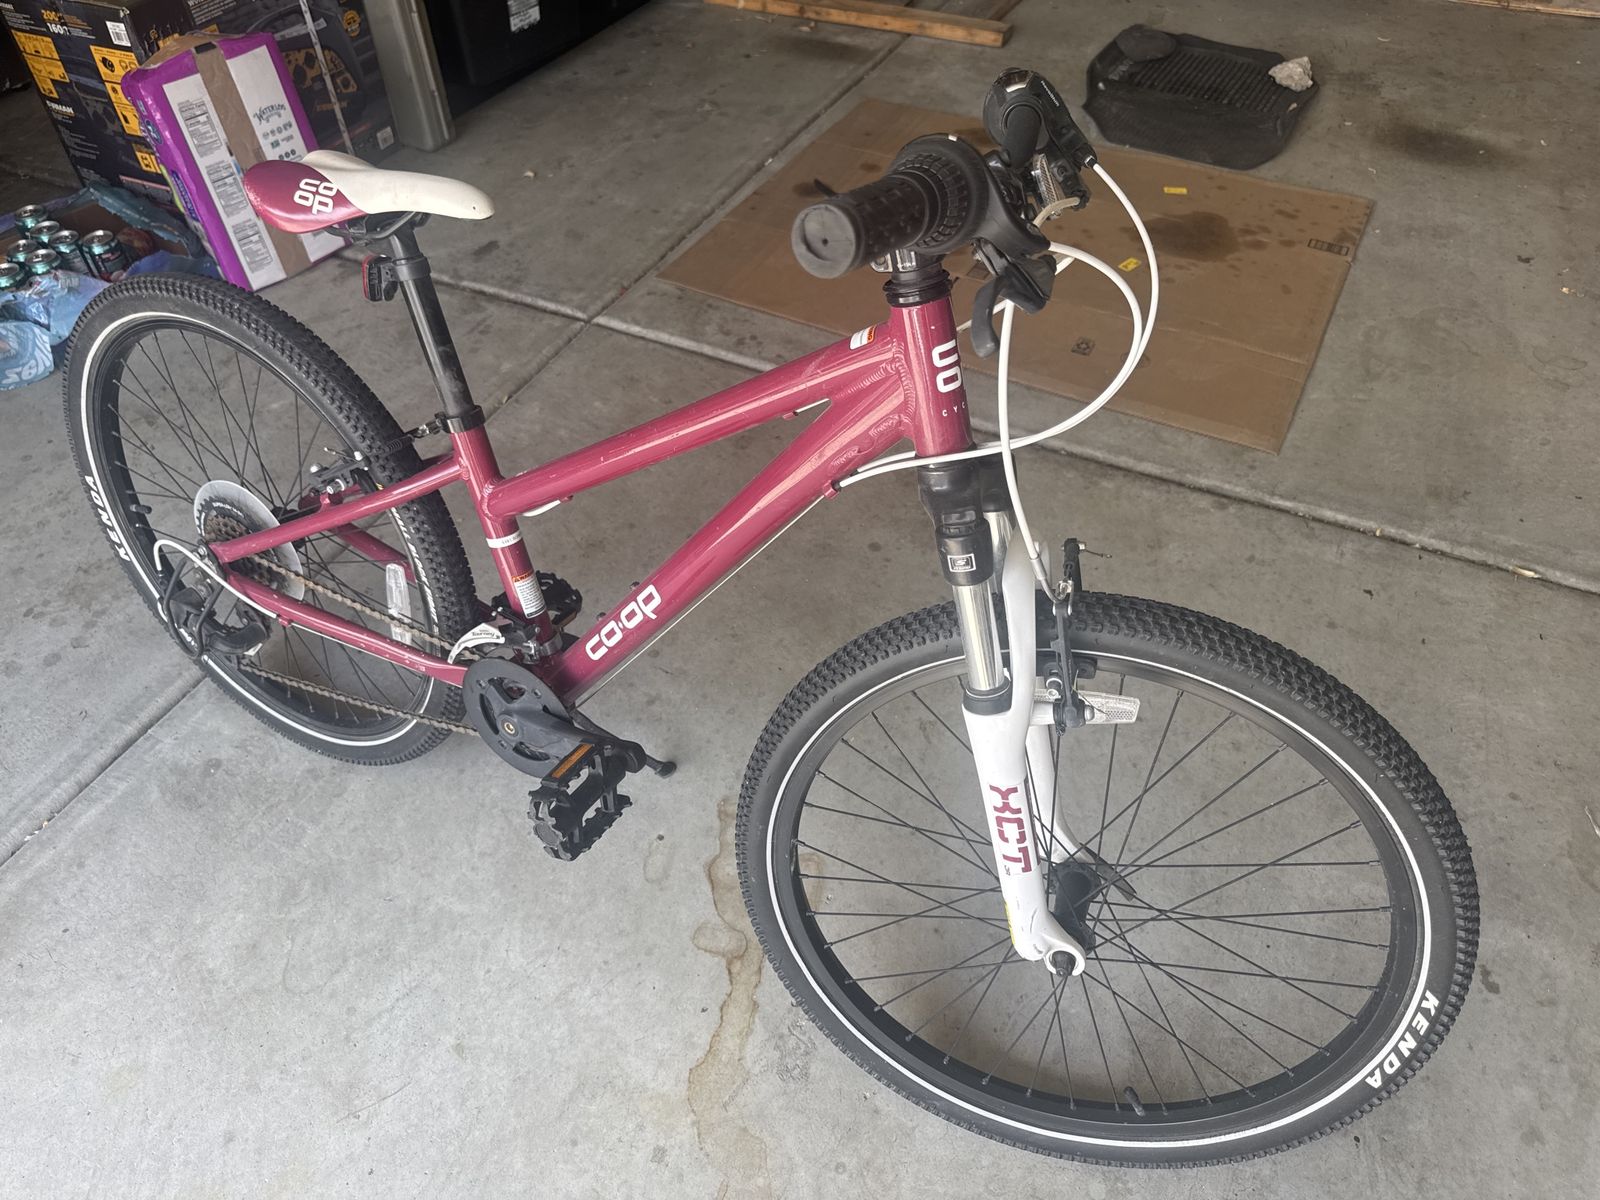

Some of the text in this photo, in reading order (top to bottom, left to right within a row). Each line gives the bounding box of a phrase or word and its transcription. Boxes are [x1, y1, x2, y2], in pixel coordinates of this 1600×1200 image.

[941, 401, 967, 418] CYC
[84, 475, 131, 562] KENDA
[989, 784, 1033, 874] XCT
[1364, 989, 1440, 1089] KENDA
